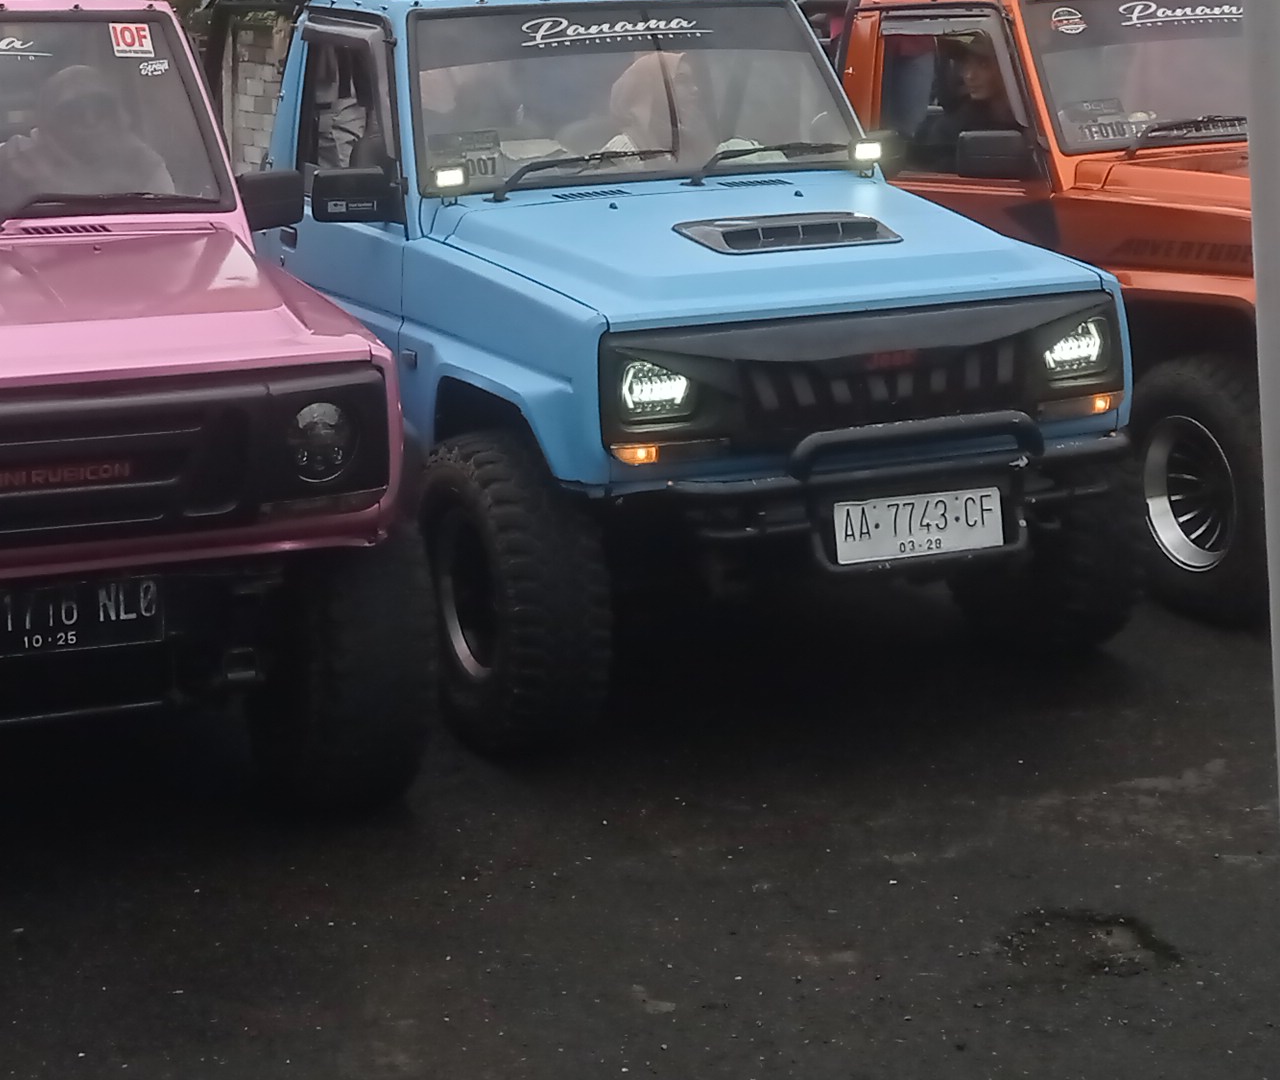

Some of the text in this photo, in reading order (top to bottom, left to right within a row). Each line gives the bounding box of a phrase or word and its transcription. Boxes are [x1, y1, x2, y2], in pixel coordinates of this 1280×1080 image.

[1118, 0, 1244, 21] Panam
[112, 26, 148, 48] IOF
[521, 17, 697, 42] Panama
[31, 463, 130, 485] RUBICON
[844, 494, 993, 542] AA 7743 CF
